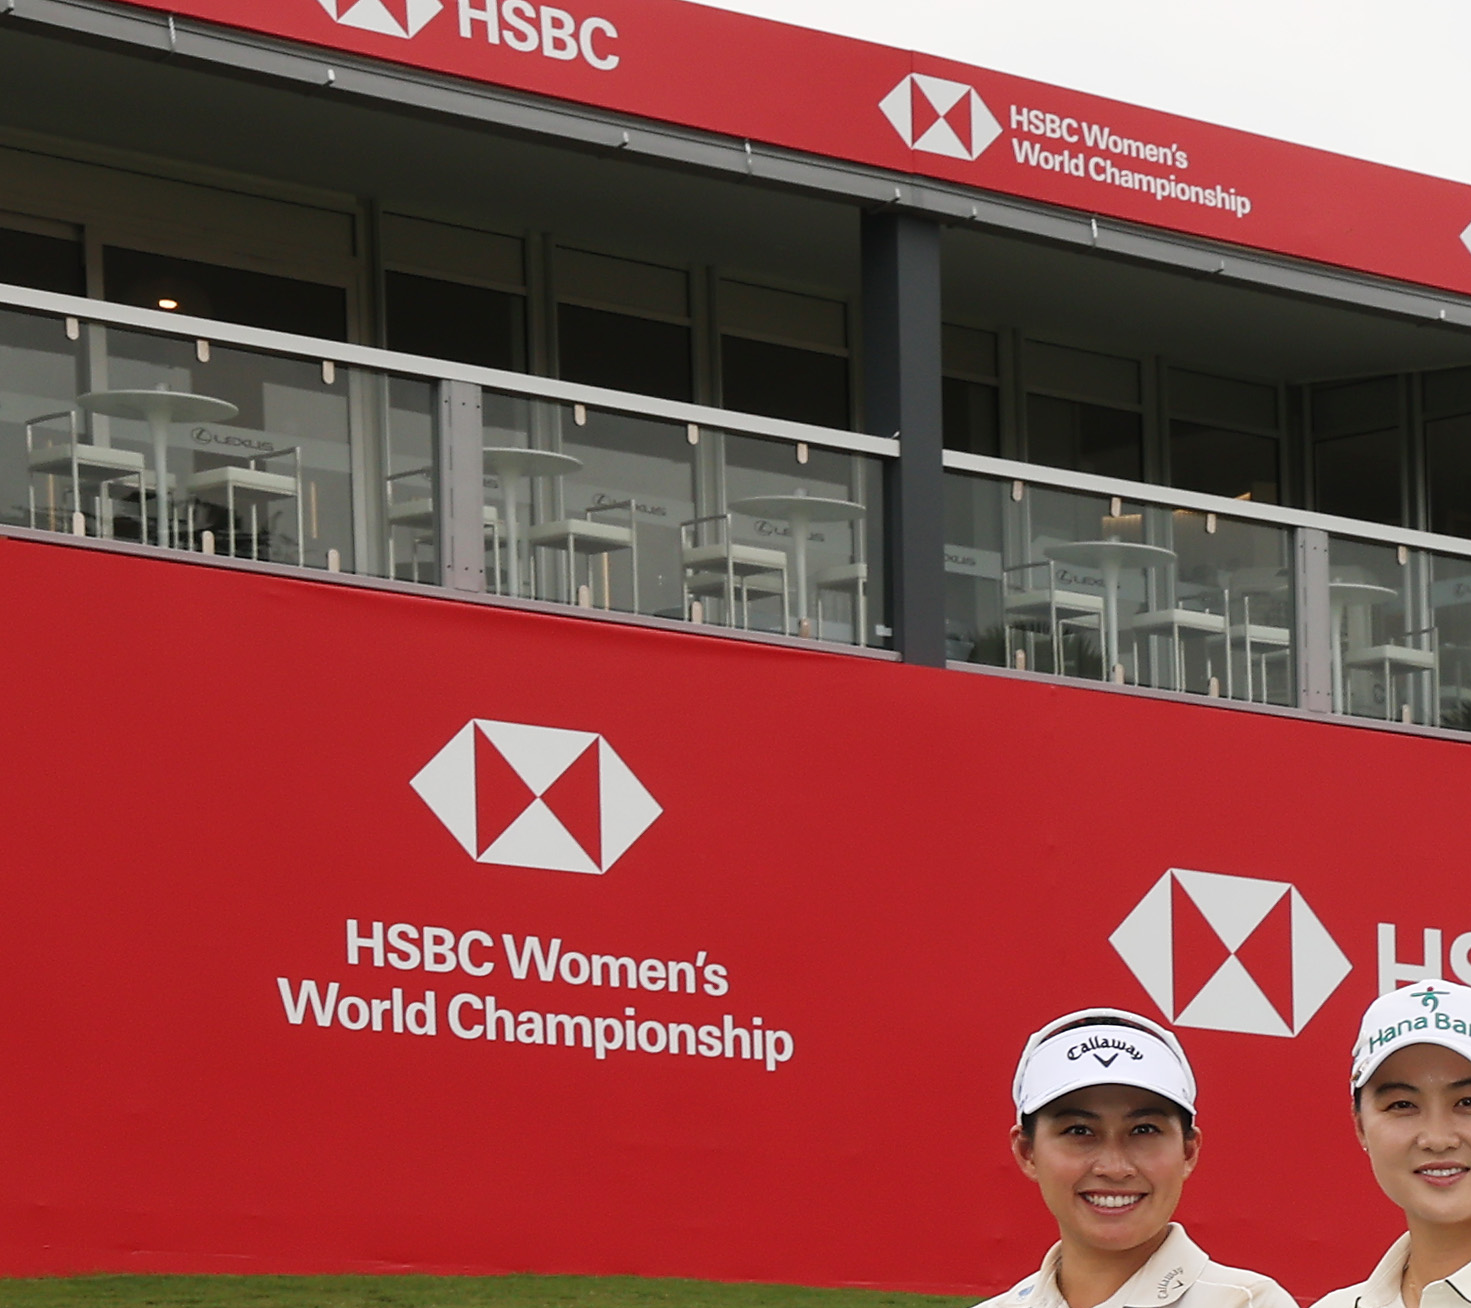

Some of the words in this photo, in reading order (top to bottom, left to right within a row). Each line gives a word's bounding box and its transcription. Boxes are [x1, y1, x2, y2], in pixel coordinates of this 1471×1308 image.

[459, 0, 619, 70] HSBC
[1010, 104, 1078, 145] HSBC
[1082, 121, 1188, 169] Women's
[1011, 138, 1085, 178] World
[1089, 156, 1251, 217] Championship
[346, 919, 494, 978] HSBC
[502, 934, 729, 997] Women's
[277, 977, 437, 1038] World
[447, 992, 795, 1072] Championship
[1066, 1036, 1144, 1061] Callaway
[1369, 1016, 1428, 1054] Hana
